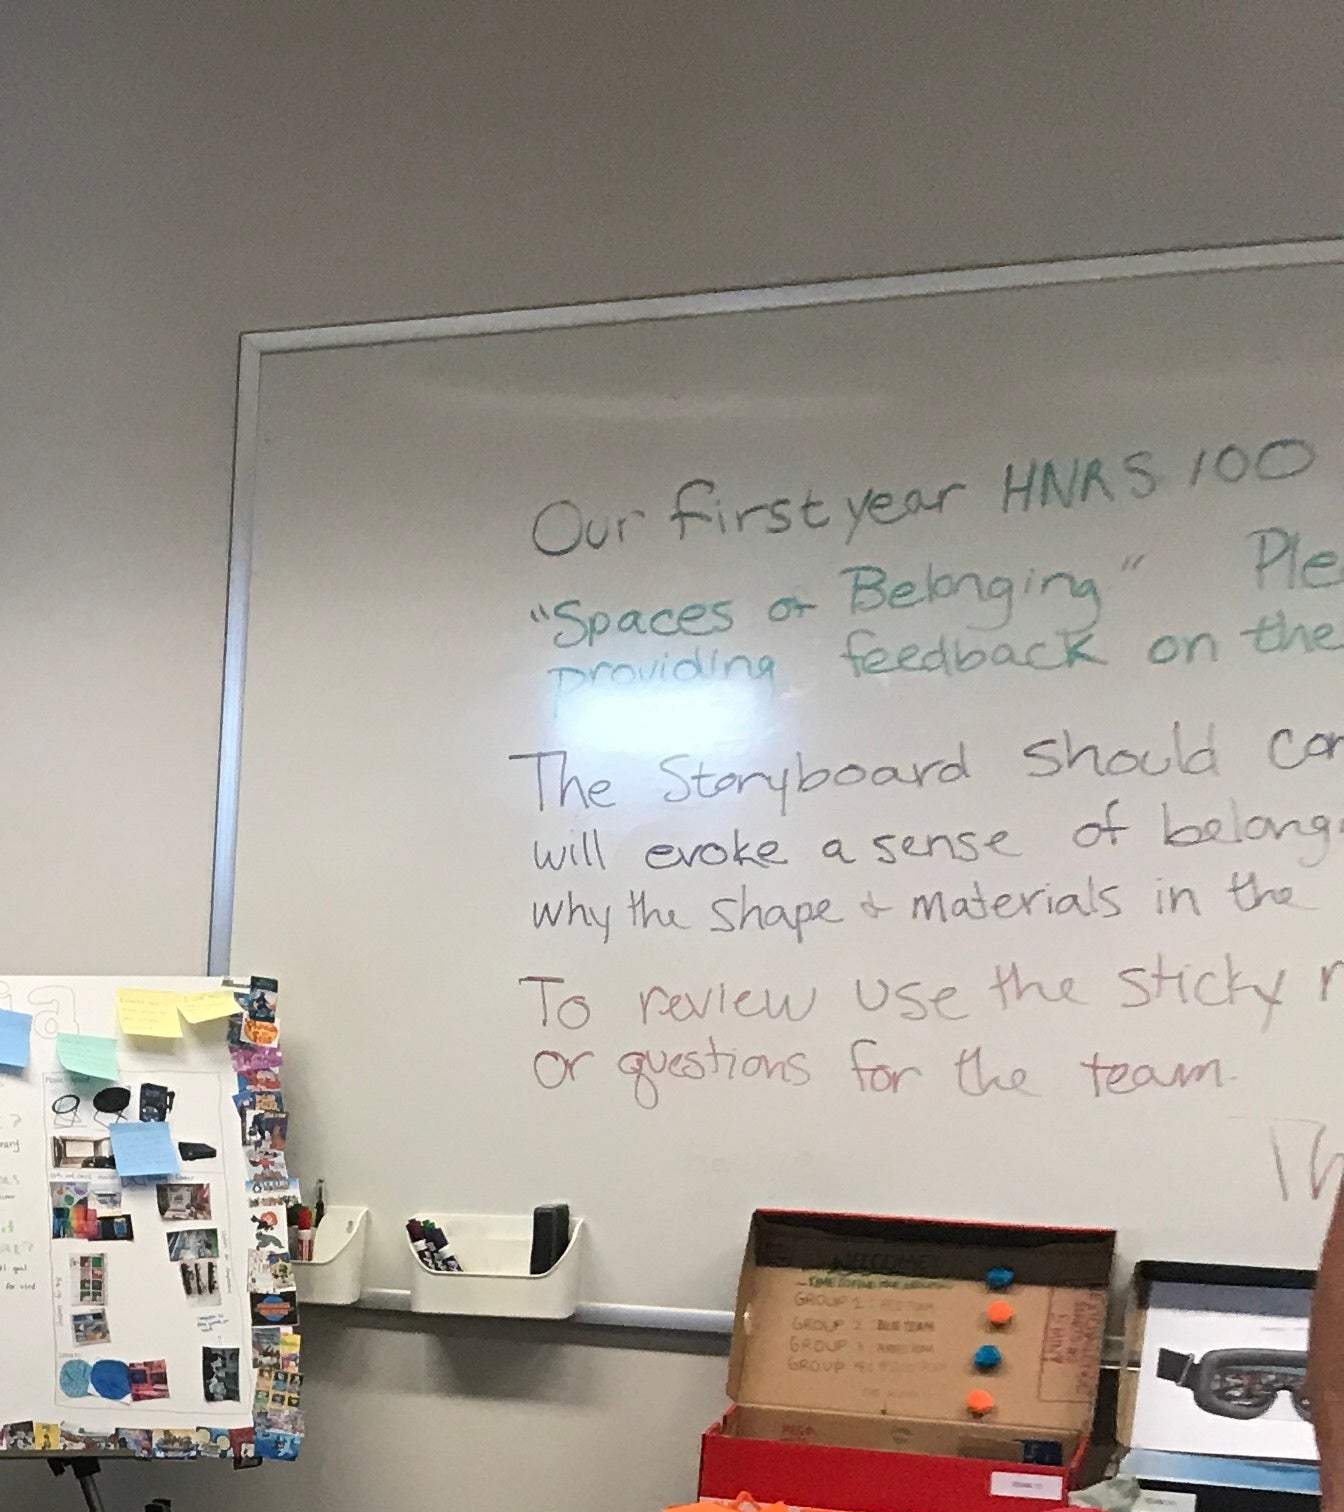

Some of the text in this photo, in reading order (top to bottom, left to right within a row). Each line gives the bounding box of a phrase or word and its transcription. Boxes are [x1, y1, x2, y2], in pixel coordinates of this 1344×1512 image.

[531, 437, 1316, 556] Our first year HNRS 100
[547, 609, 1344, 718] providing feedback on the
[508, 750, 616, 812] The
[658, 741, 971, 817] Storyboard
[533, 796, 1344, 872] will evoke a sense of belong
[627, 889, 691, 931] the
[1155, 877, 1202, 917] in
[1227, 871, 1319, 913] the
[518, 975, 591, 1030] To
[639, 982, 817, 1026] review
[989, 960, 1090, 1011] the
[1118, 952, 1287, 1034] sticky
[532, 1049, 596, 1090] or
[617, 1034, 811, 1110] questions
[850, 1038, 923, 1093] for
[955, 1045, 1042, 1097] the
